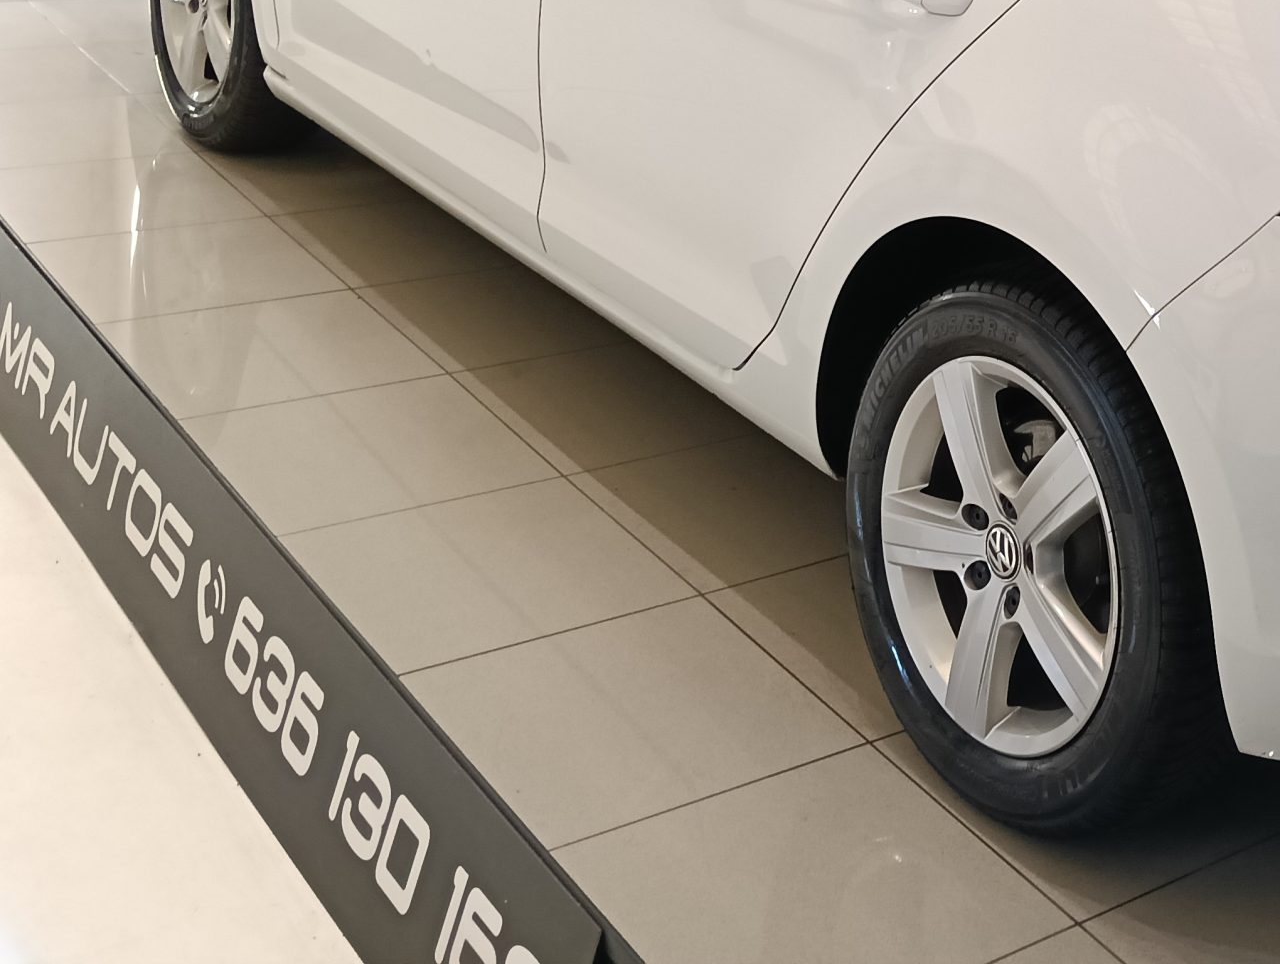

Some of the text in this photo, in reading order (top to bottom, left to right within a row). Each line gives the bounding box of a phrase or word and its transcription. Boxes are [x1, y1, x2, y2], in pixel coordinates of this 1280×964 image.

[0, 301, 541, 964] MR AUTOS 636 130 16
